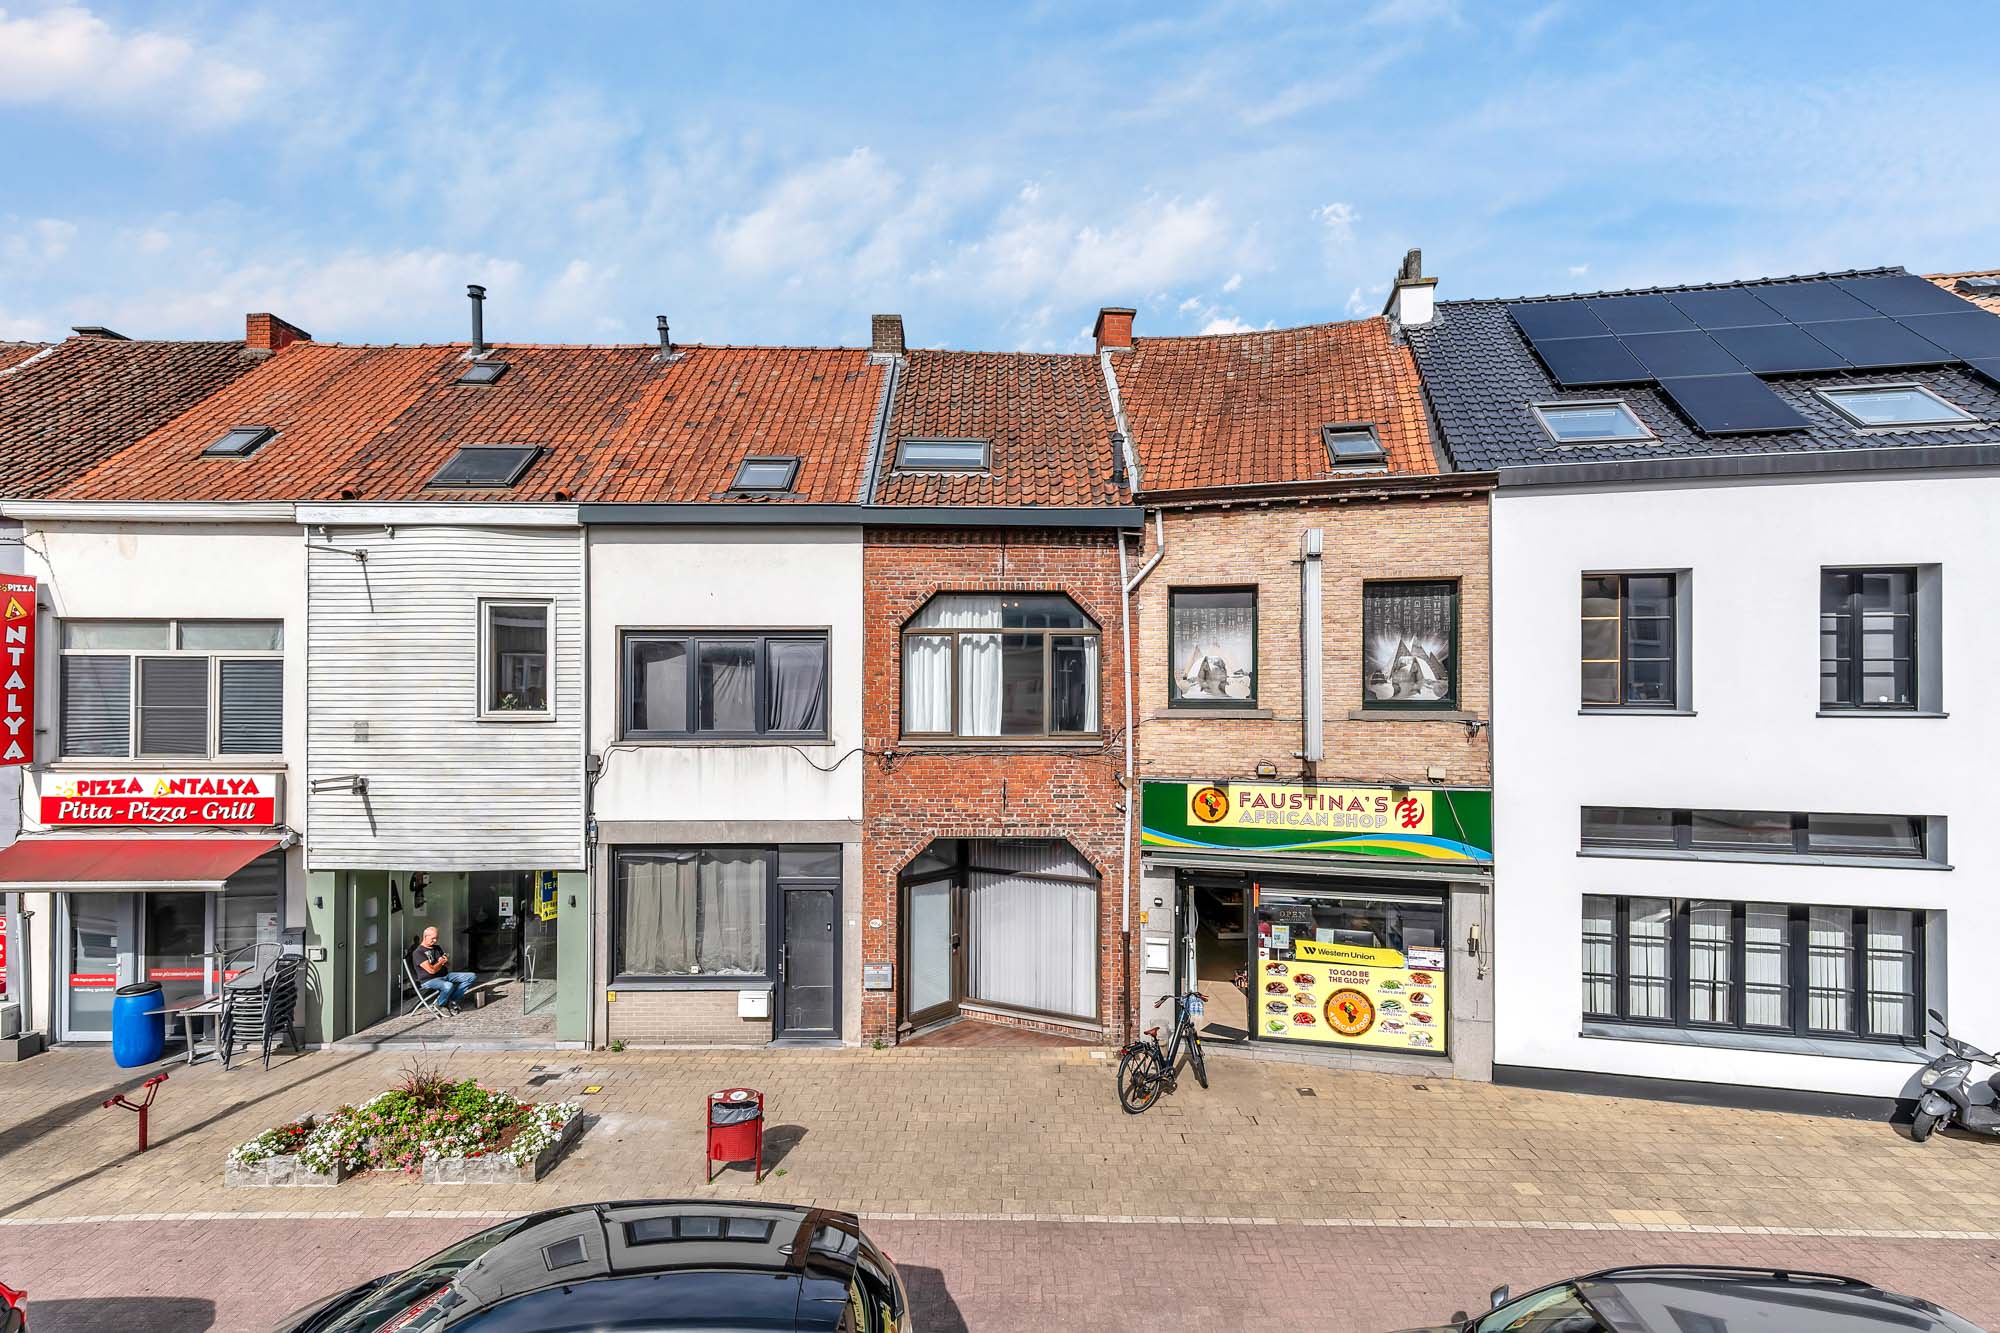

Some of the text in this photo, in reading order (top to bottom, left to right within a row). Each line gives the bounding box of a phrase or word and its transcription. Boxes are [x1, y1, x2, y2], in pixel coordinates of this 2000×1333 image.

[8, 584, 35, 592] PIZZA
[4, 596, 27, 760] ANTALYA
[76, 777, 260, 798] PIZZA ANTALYA
[1239, 791, 1389, 813] FAUSTINA'S
[58, 801, 113, 820] Pitta
[128, 801, 187, 823] Pizza
[202, 801, 256, 820] Grill
[1239, 809, 1388, 829] AFRICAN SHOP
[1280, 910, 1306, 918] OPEN
[1318, 948, 1350, 958] Western
[1351, 951, 1376, 961] Union
[1340, 969, 1358, 977] GOD
[1359, 970, 1370, 978] BE
[1344, 977, 1371, 985] GLORY
